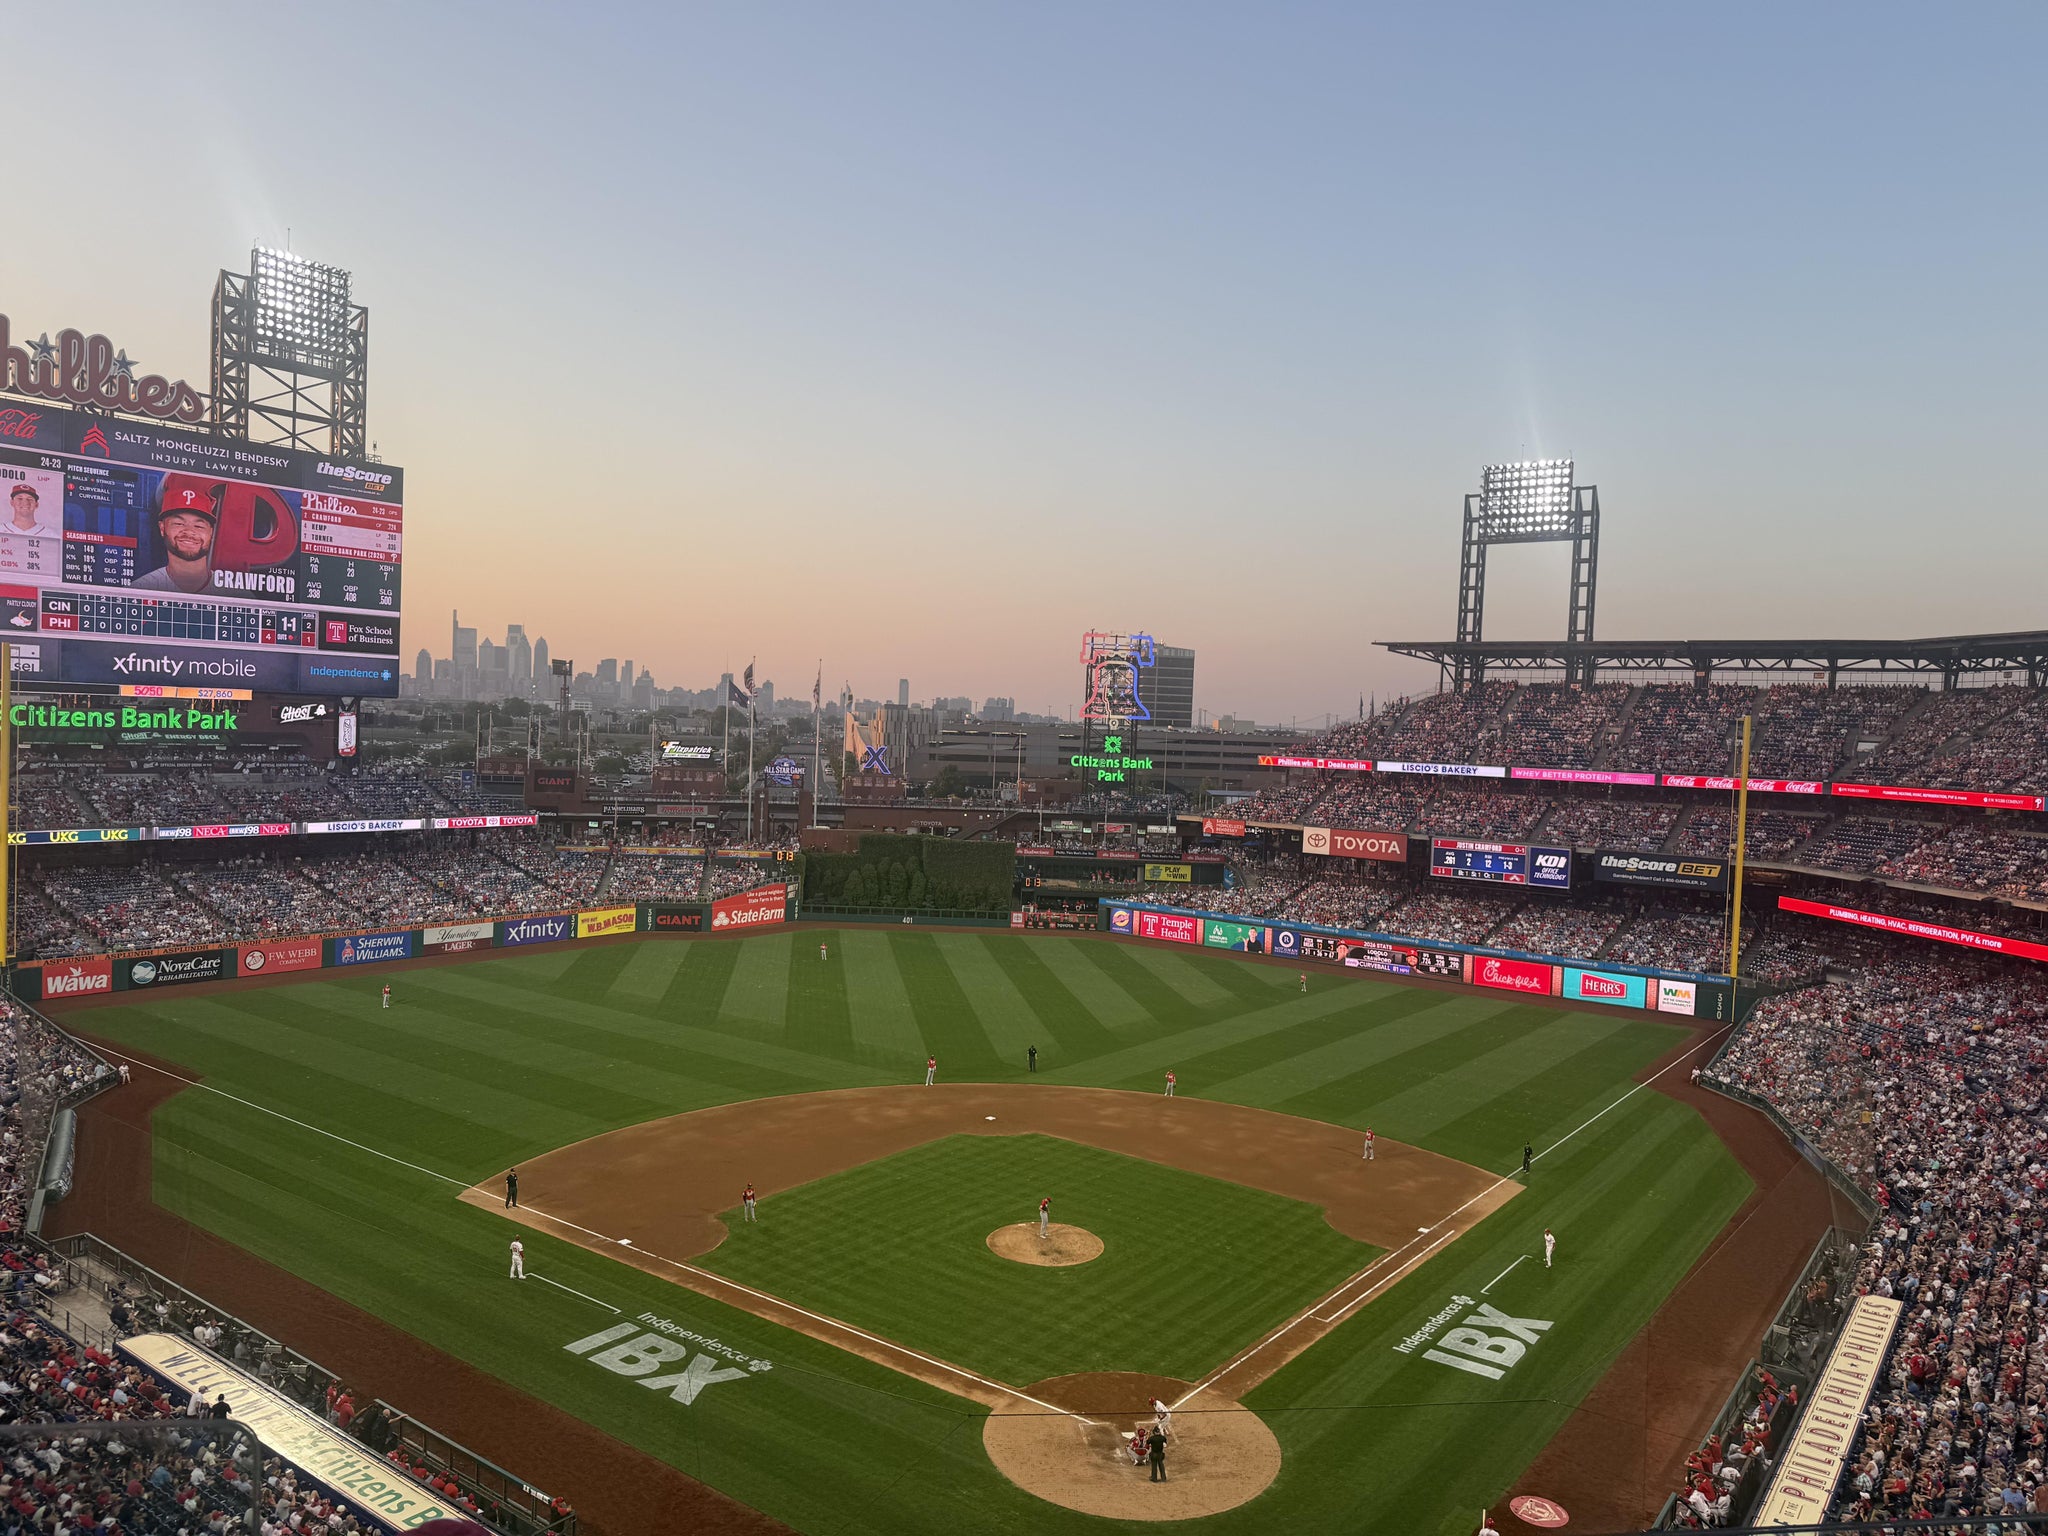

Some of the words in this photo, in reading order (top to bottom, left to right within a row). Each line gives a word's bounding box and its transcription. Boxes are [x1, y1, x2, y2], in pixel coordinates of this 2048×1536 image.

[115, 431, 150, 446] SALTZ
[156, 438, 230, 458] MONGELUZZI
[234, 451, 289, 468] BENDESKY
[41, 456, 61, 469] 24-23
[151, 453, 196, 467] INJURY
[205, 461, 257, 477] LAWYERS
[0, 468, 26, 481] DOLO
[67, 464, 83, 473] PITCH
[83, 467, 109, 477] SEQUENCE
[316, 461, 392, 485] theScore
[79, 485, 110, 494] CURVEBALL
[79, 492, 110, 502] CURVEBALL
[302, 492, 358, 515] Phillies
[311, 514, 342, 523] CRAWFORD
[311, 523, 327, 532] KEMP
[66, 531, 86, 541] SEASON
[88, 533, 104, 542] STATS
[311, 533, 333, 543] TURNER
[313, 545, 337, 554] CITIZENS
[338, 547, 353, 556] BANK
[353, 549, 367, 558] PARK
[310, 556, 320, 564] PA
[269, 567, 296, 577] JUSTIN
[379, 564, 394, 573] XBH
[214, 569, 295, 595] CRAWFORD
[383, 572, 388, 581] 7
[306, 581, 322, 589] AVG
[378, 588, 393, 596] SLG
[7, 599, 21, 607] PARTLY
[49, 601, 71, 611] CIN
[84, 604, 90, 612] 0
[100, 605, 106, 613] 2
[116, 606, 122, 615] 0
[131, 608, 138, 616] 0
[147, 609, 153, 617] 0
[222, 615, 228, 623] 2
[236, 616, 242, 624] 3
[250, 617, 256, 625] 0
[266, 618, 272, 626] 2
[306, 621, 312, 629] 2
[49, 617, 71, 628] PHI
[84, 620, 90, 628] 2
[100, 621, 106, 629] 0
[116, 622, 122, 631] 0
[131, 623, 138, 631] 0
[222, 630, 228, 638] 2
[249, 632, 256, 640] 0
[349, 624, 363, 634] Fox
[365, 625, 392, 635] School
[349, 633, 358, 642] of
[358, 635, 393, 645] Business
[112, 652, 184, 677] xfinity
[189, 659, 257, 678] mobile
[310, 665, 379, 680] Independence
[198, 689, 233, 698] $27,860
[9, 705, 116, 728] Citizens
[121, 707, 183, 728] Bank
[187, 709, 238, 731] Park
[280, 704, 318, 723] GHOST
[663, 741, 713, 755] Fitzpatrick
[1070, 755, 1120, 769] Citizens
[1122, 756, 1153, 770] Bank
[1278, 758, 1301, 767] Phillies
[764, 765, 775, 773] ALL
[776, 765, 790, 774] STAR
[790, 765, 806, 775] GAME
[1402, 763, 1440, 773] LISCIO'S
[1441, 765, 1478, 775] BAKERY
[537, 777, 572, 785] GIANT
[1097, 769, 1125, 782] Park
[1515, 770, 1541, 779] WHEY
[1542, 771, 1573, 780] BETTER
[1575, 772, 1612, 782] PROTEIN
[1667, 775, 1695, 788] Coca-Cola
[1705, 777, 1734, 790] Coca-Cola
[1785, 782, 1817, 794] Coca-Cola
[328, 822, 367, 832] LISCIO'S
[368, 821, 403, 830] BAKERY
[451, 817, 484, 826] TOYOTA
[503, 816, 534, 825] TOYOTA
[100, 829, 129, 841] UKG
[196, 826, 223, 836] NECA
[262, 824, 289, 835] NECA
[49, 831, 79, 843] UKG
[1333, 834, 1401, 855] TOYOTA
[1456, 841, 1475, 850] JUSTIN
[1475, 843, 1503, 852] CRAWFORD
[1466, 858, 1471, 866] 2
[1485, 859, 1492, 868] 12
[1535, 855, 1567, 869] KDI
[1600, 856, 1677, 873] theScore
[1681, 863, 1718, 876] BET
[1165, 866, 1181, 874] PLAY
[1172, 873, 1187, 881] WIN!
[1533, 872, 1567, 882] TECHNOLOGY
[657, 915, 700, 926] GIANT
[902, 916, 913, 925] 401
[1160, 917, 1193, 931] Temple
[508, 919, 564, 943] xfinity
[1161, 927, 1191, 941] Health
[1829, 909, 1859, 922] PLUMBING,
[1860, 913, 1887, 927] HEATING,
[1887, 919, 1908, 931] HVAC,
[1908, 923, 1960, 942] REFRIGERATION,
[1961, 933, 1974, 943] PVF
[1982, 938, 2002, 948] more
[437, 927, 481, 943] Yuengling
[357, 936, 404, 949] SHERWIN
[444, 941, 473, 952] LAGER
[105, 950, 154, 960] ASPLUNDH
[163, 945, 209, 955] ASPLUNDH
[268, 951, 286, 962] F.W.
[288, 947, 317, 958] WEBB
[43, 956, 96, 966] ASPLUNDH
[157, 957, 221, 975] NovaCare
[279, 958, 306, 966] COMPANY
[1359, 961, 1391, 971] CURVEBALL
[158, 969, 218, 982] REHABILITATION
[1482, 960, 1541, 990] Chick-fil-A
[47, 973, 108, 994] Wawa
[1585, 979, 1622, 995] HERR'S
[1663, 987, 1691, 999] WM
[1716, 993, 1724, 1020] 330
[1392, 1301, 1467, 1354] Independence
[1840, 1300, 1894, 1366] PHILLIES
[636, 1311, 749, 1362] Independence
[1421, 1302, 1555, 1381] IBX
[562, 1321, 751, 1406] IBX
[159, 1351, 287, 1423] WELCOME
[1779, 1367, 1868, 1505] PHILADELPHIA
[314, 1446, 417, 1515] Citizens
